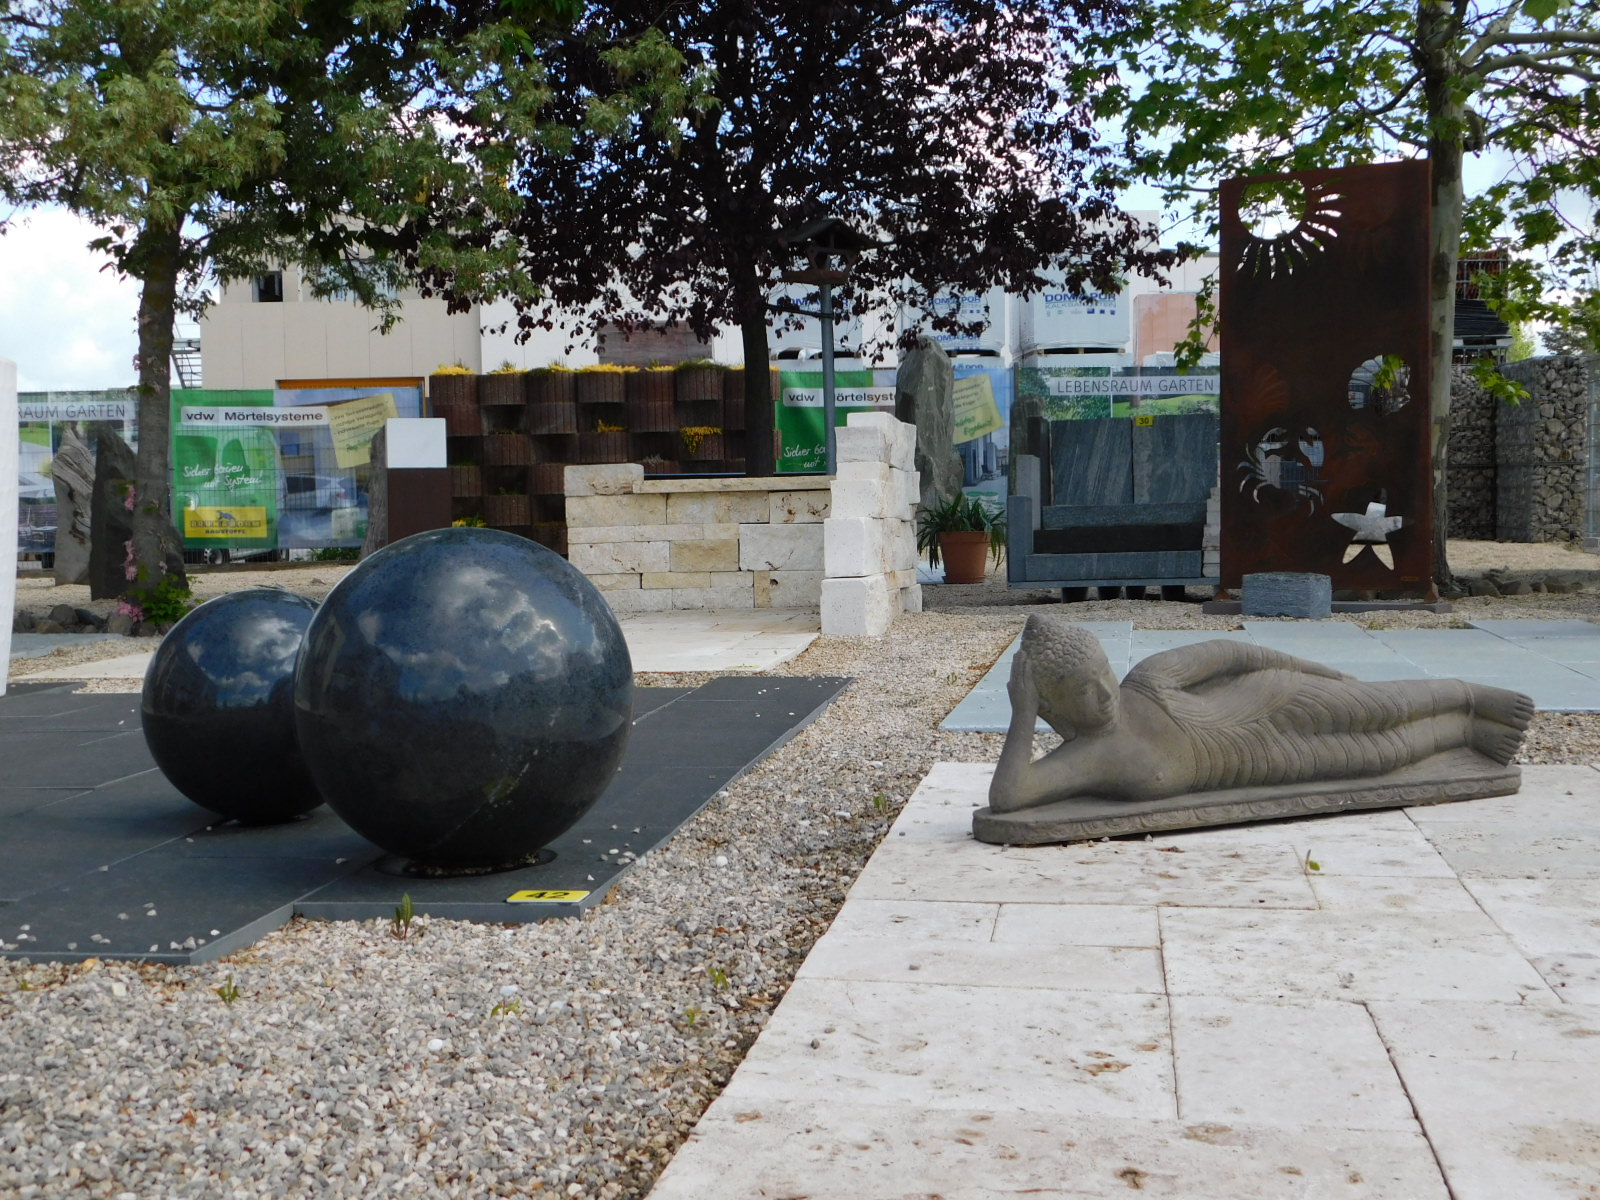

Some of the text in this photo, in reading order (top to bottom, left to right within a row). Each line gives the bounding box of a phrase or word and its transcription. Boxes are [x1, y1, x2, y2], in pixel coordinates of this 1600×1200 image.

[1057, 378, 1214, 393] LEBENSRAUM GARTEN
[788, 392, 815, 402] vdw
[65, 404, 125, 418] GARTEN
[186, 411, 215, 421] vdw
[224, 411, 324, 423] Mörtelsysteme
[1138, 417, 1150, 425] 30
[783, 444, 812, 457] Sicher
[183, 464, 210, 477] Sicher
[526, 891, 570, 899] 42
